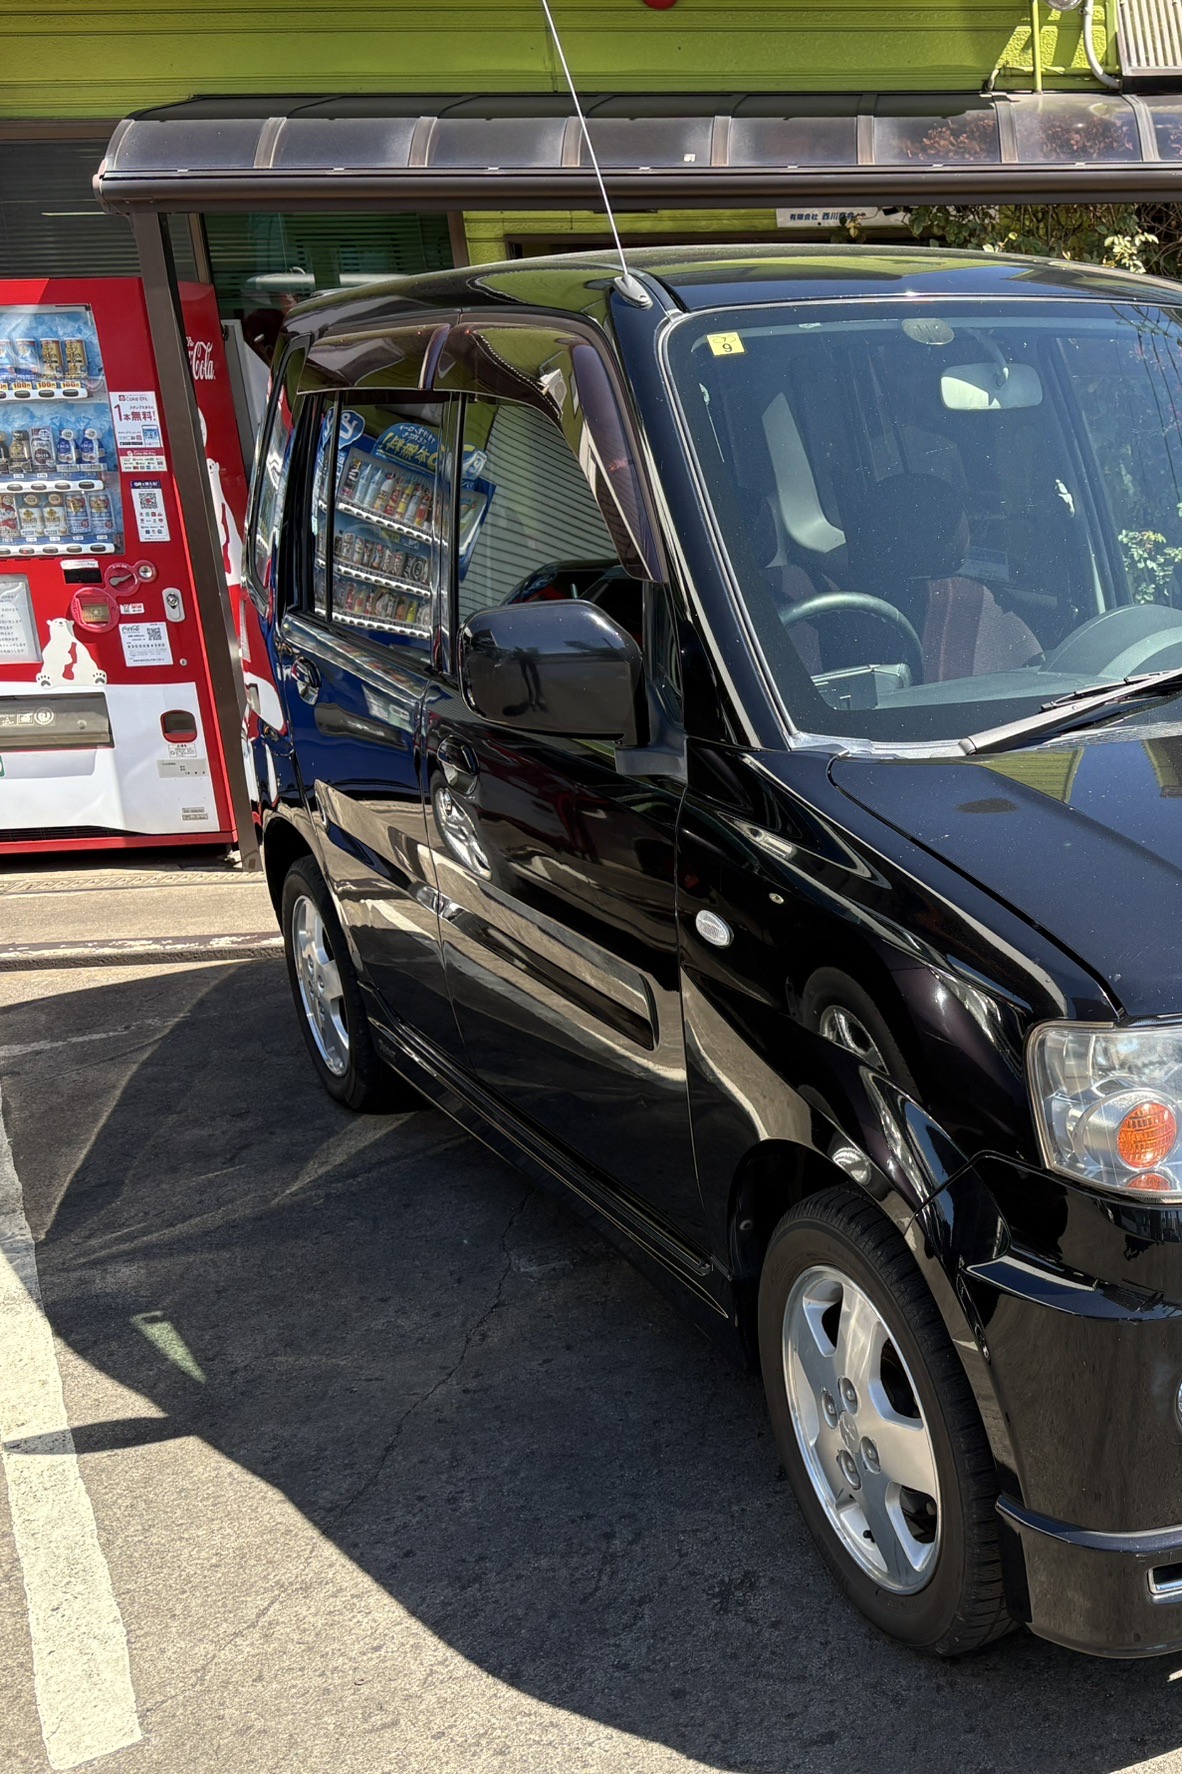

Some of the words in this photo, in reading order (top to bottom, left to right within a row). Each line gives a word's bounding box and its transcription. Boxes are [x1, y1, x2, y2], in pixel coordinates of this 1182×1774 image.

[790, 213, 819, 221] 有限会社
[722, 343, 733, 353] 9
